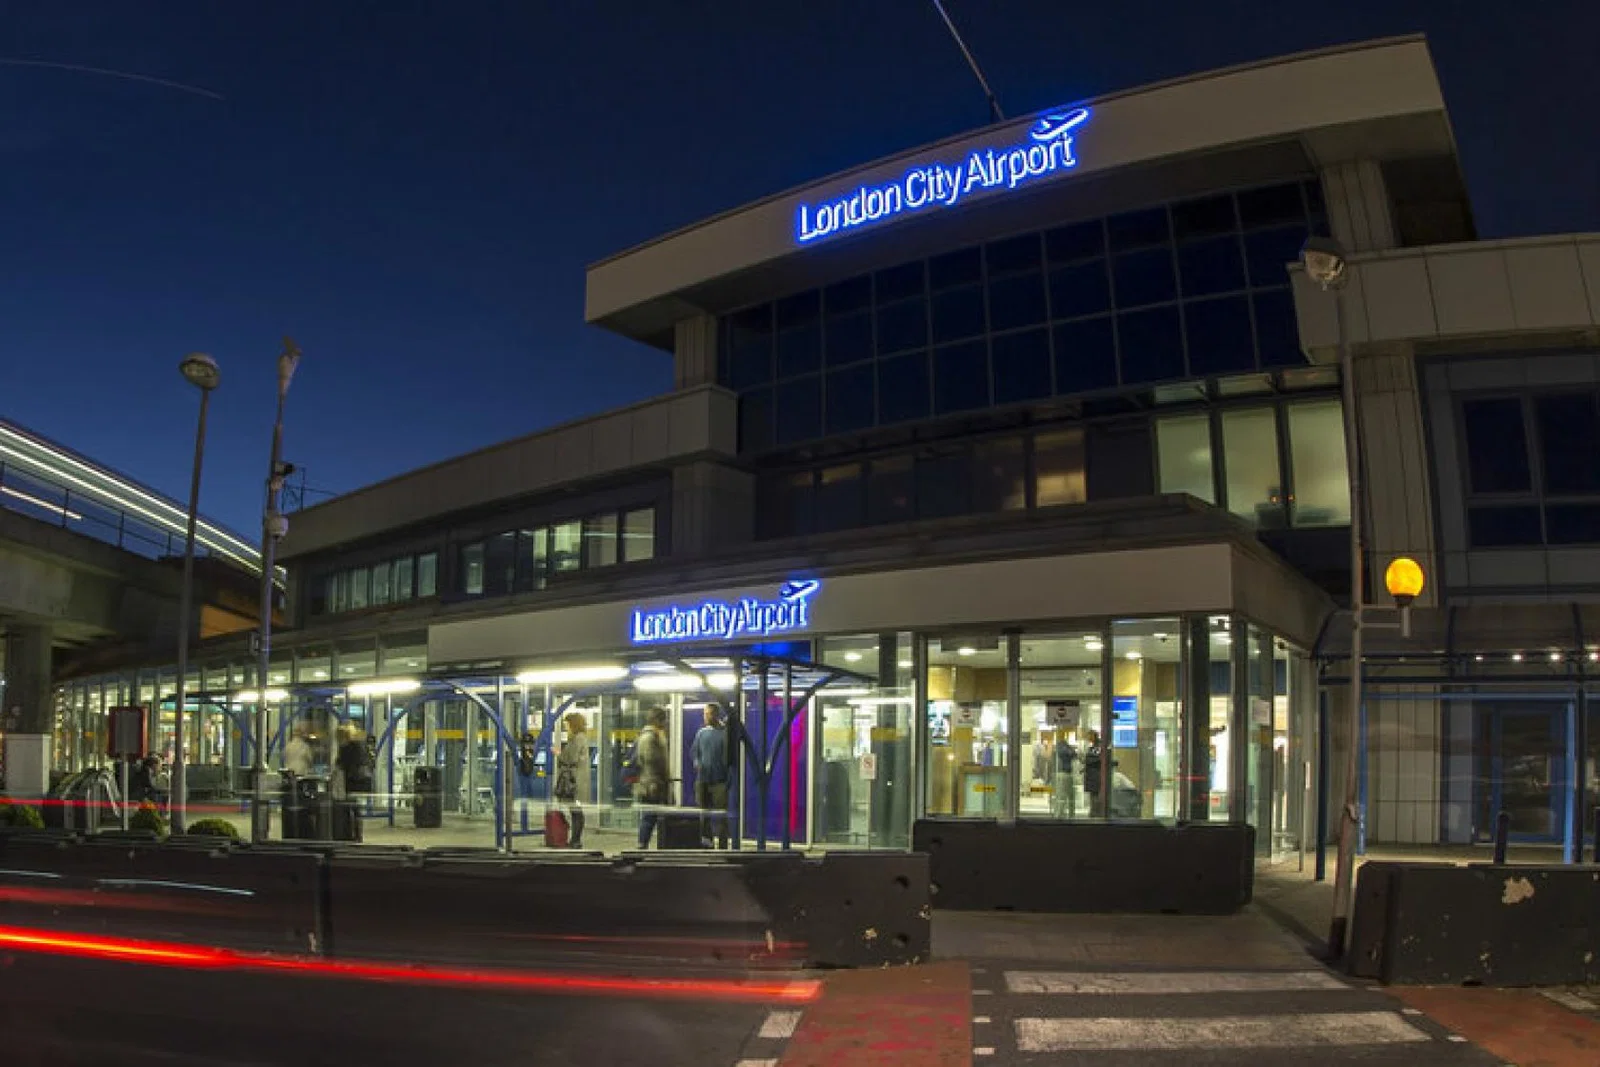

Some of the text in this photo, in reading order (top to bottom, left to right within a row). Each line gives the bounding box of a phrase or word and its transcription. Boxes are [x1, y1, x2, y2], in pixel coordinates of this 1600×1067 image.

[799, 131, 1076, 240] London City Airport
[632, 595, 808, 642] London City Airport
